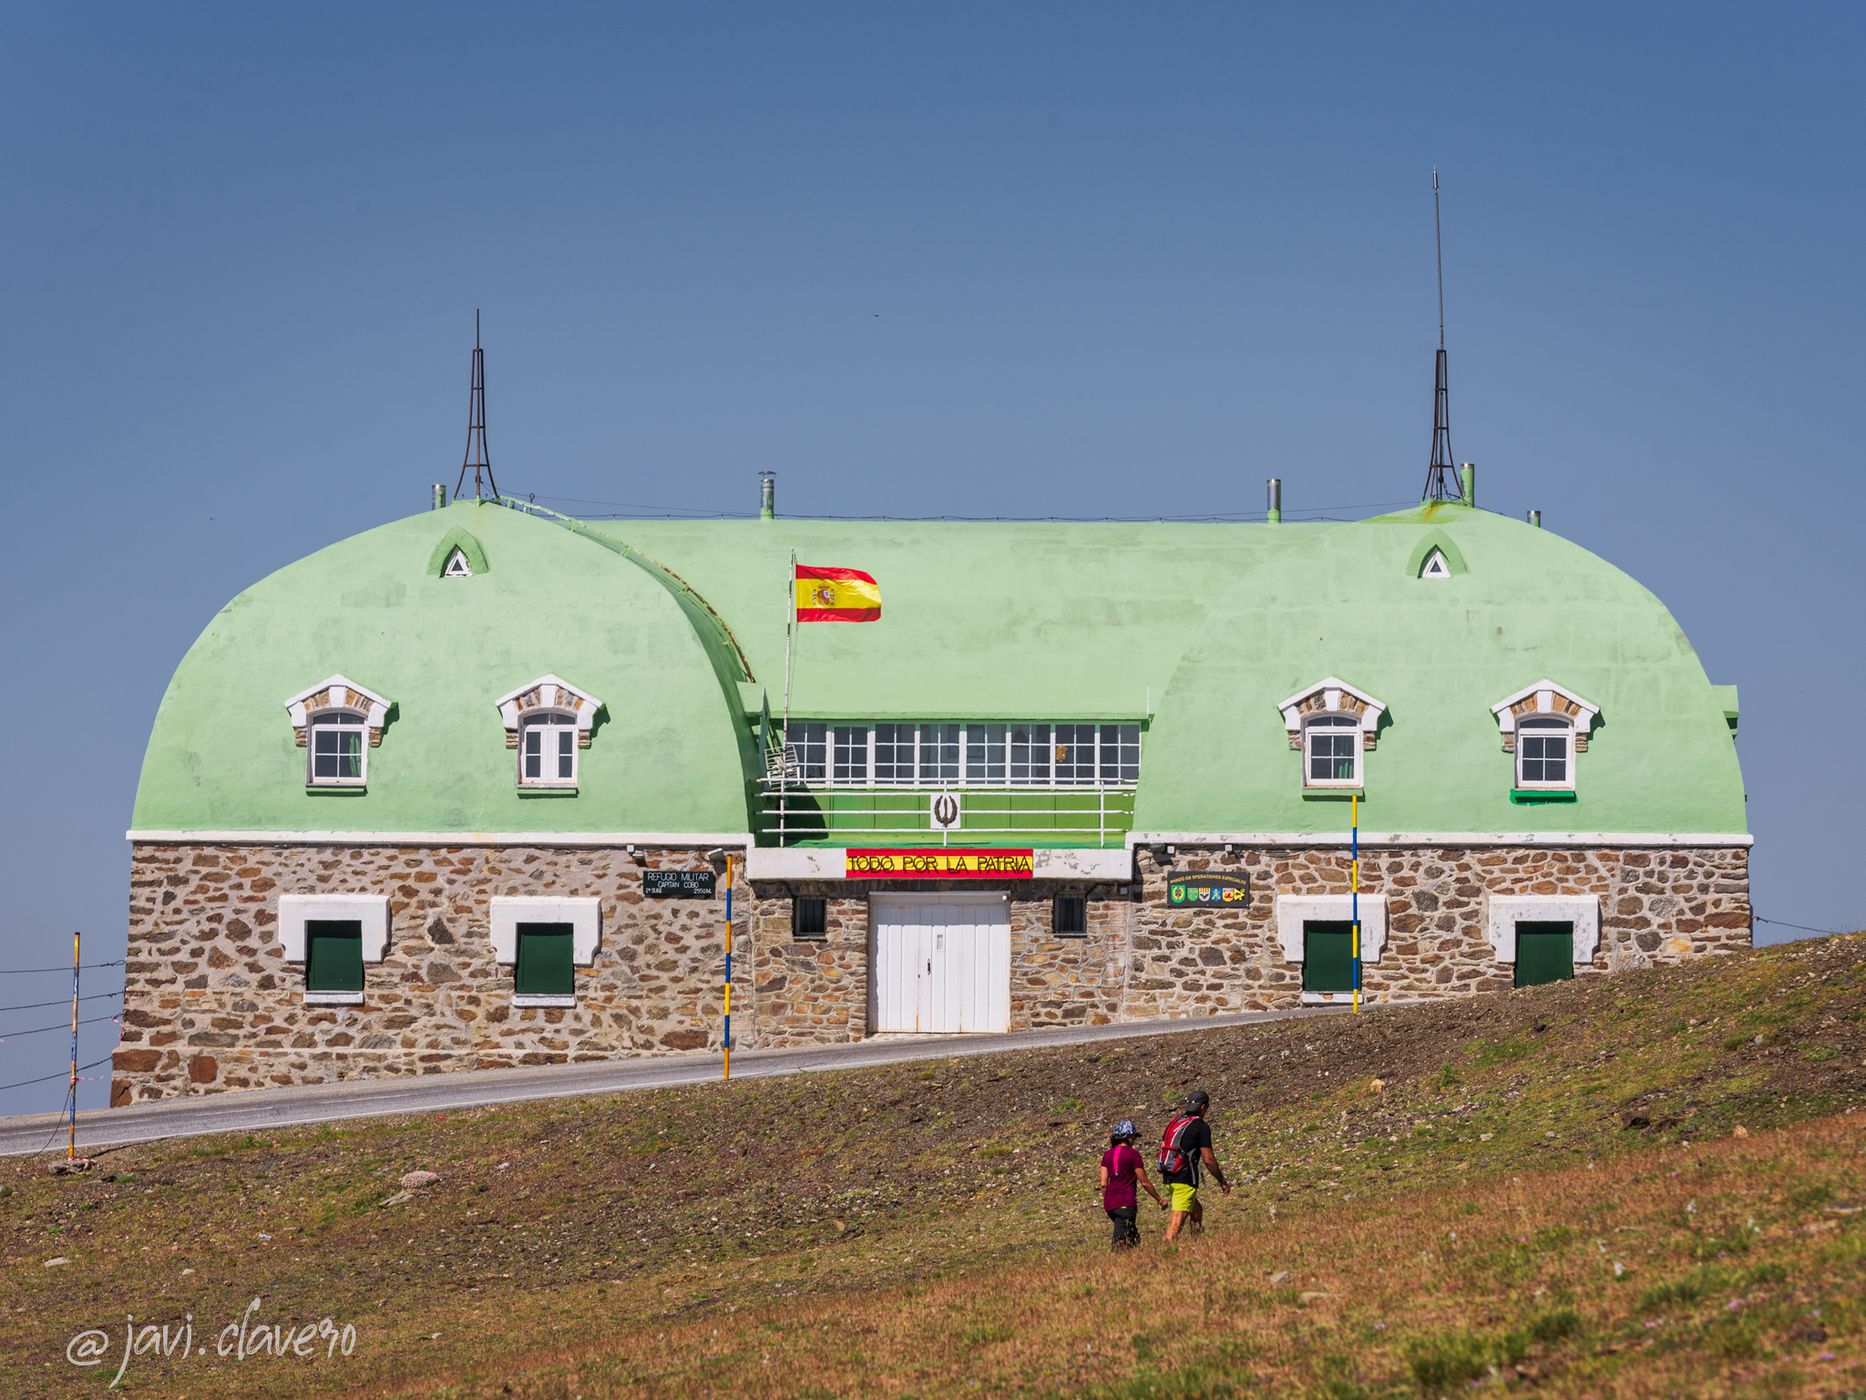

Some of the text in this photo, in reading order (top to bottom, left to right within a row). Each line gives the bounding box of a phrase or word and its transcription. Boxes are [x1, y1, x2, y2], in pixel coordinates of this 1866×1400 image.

[847, 856, 1032, 874] TODO POR LA PATRIA
[647, 872, 709, 882] REFUGIO MILITAR
[683, 881, 699, 889] COBO
